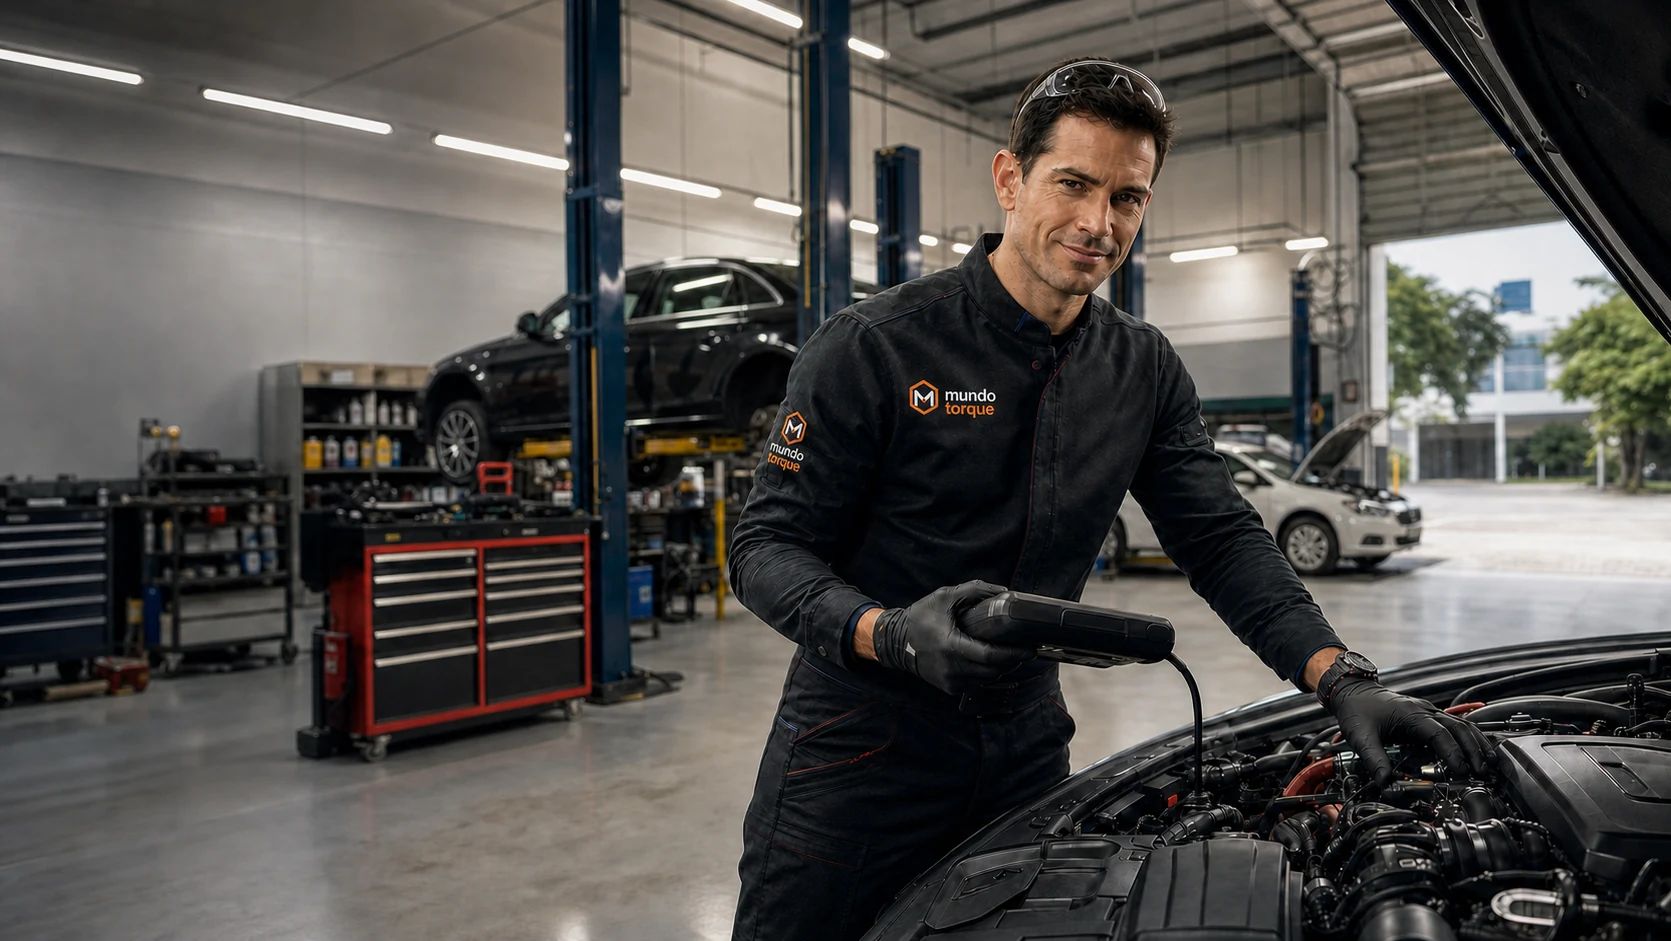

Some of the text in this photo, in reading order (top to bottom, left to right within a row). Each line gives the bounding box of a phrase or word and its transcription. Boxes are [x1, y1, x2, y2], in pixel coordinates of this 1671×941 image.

[945, 388, 996, 402] mundo
[945, 402, 994, 418] torque
[769, 442, 804, 461] mundo
[767, 452, 801, 472] torque
